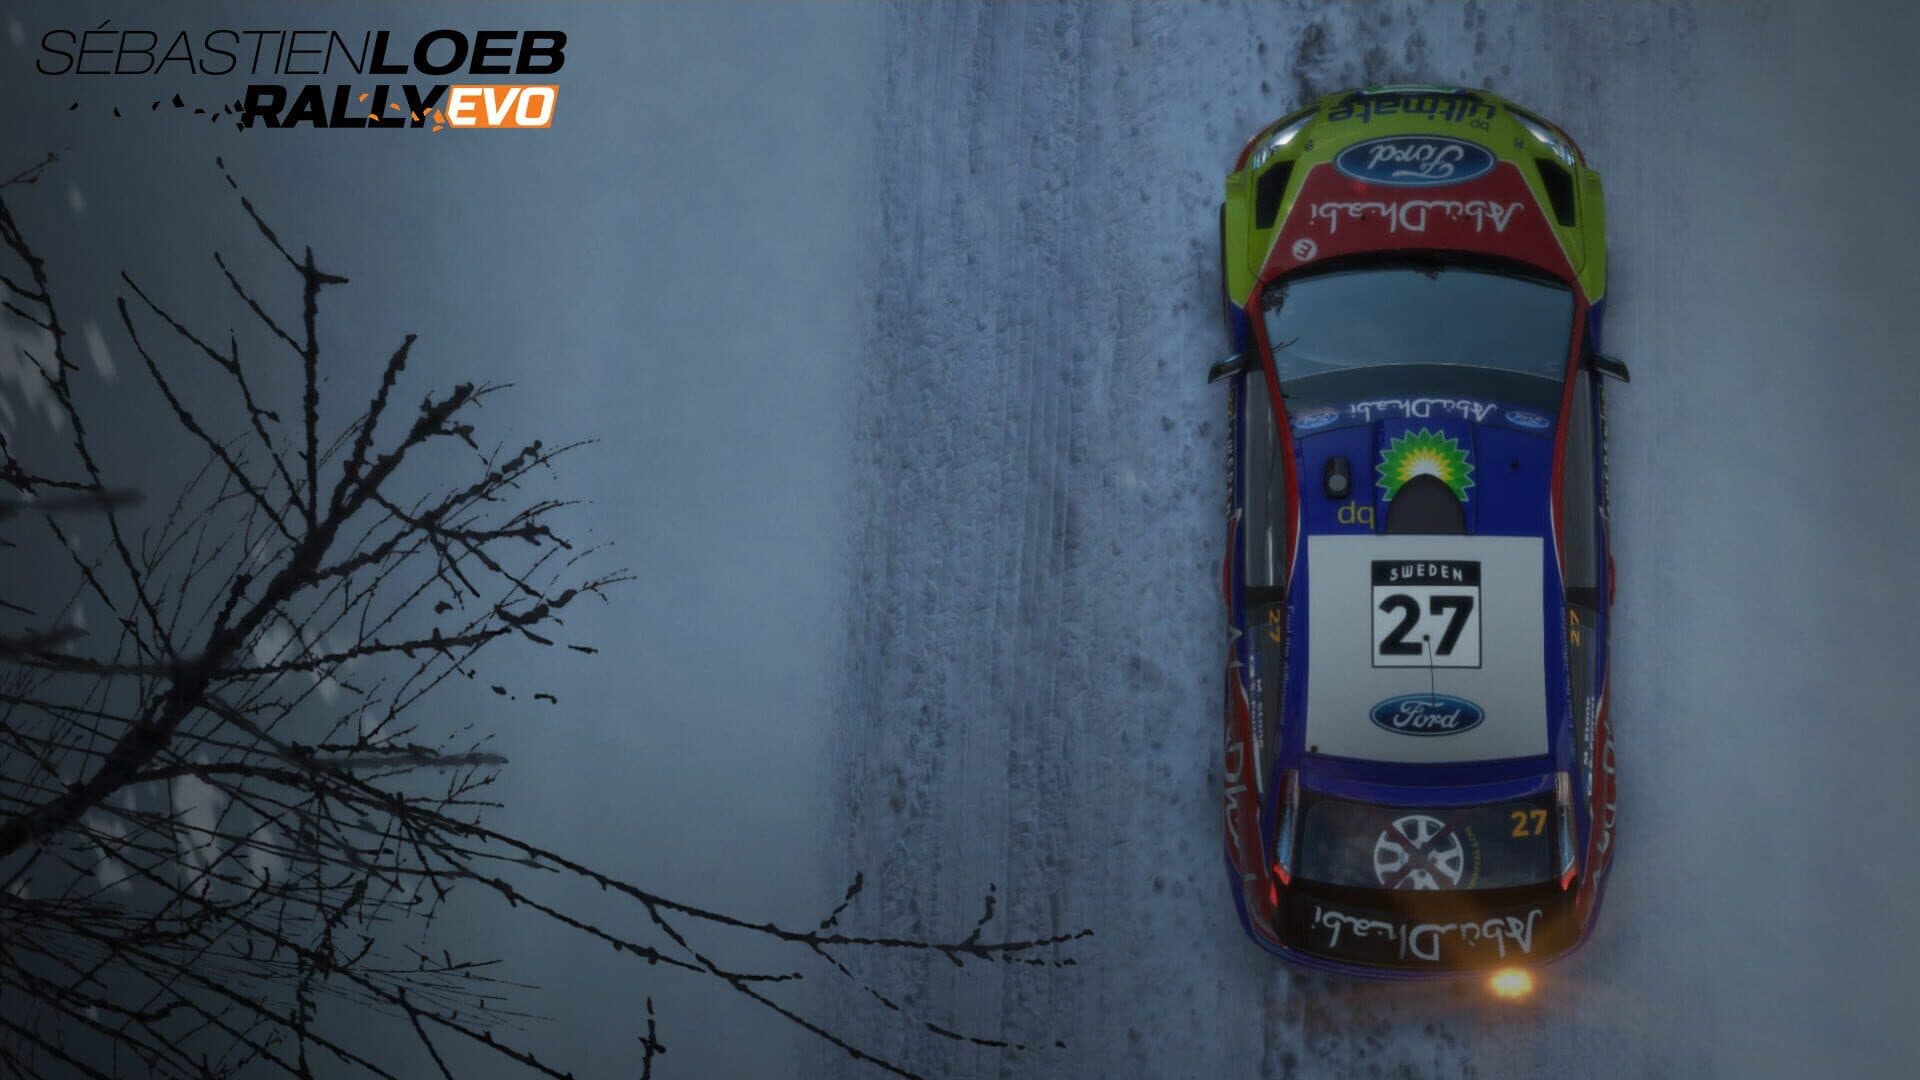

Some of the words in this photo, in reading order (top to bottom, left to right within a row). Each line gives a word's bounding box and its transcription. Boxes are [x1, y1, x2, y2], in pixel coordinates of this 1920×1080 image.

[1328, 97, 1497, 124] ultimate
[1368, 143, 1466, 178] Ford
[1337, 501, 1376, 529] bp
[1389, 560, 1464, 583] SWEDEN
[1377, 593, 1475, 656] 27
[1392, 700, 1461, 730] Ford
[1510, 809, 1549, 838] 27
